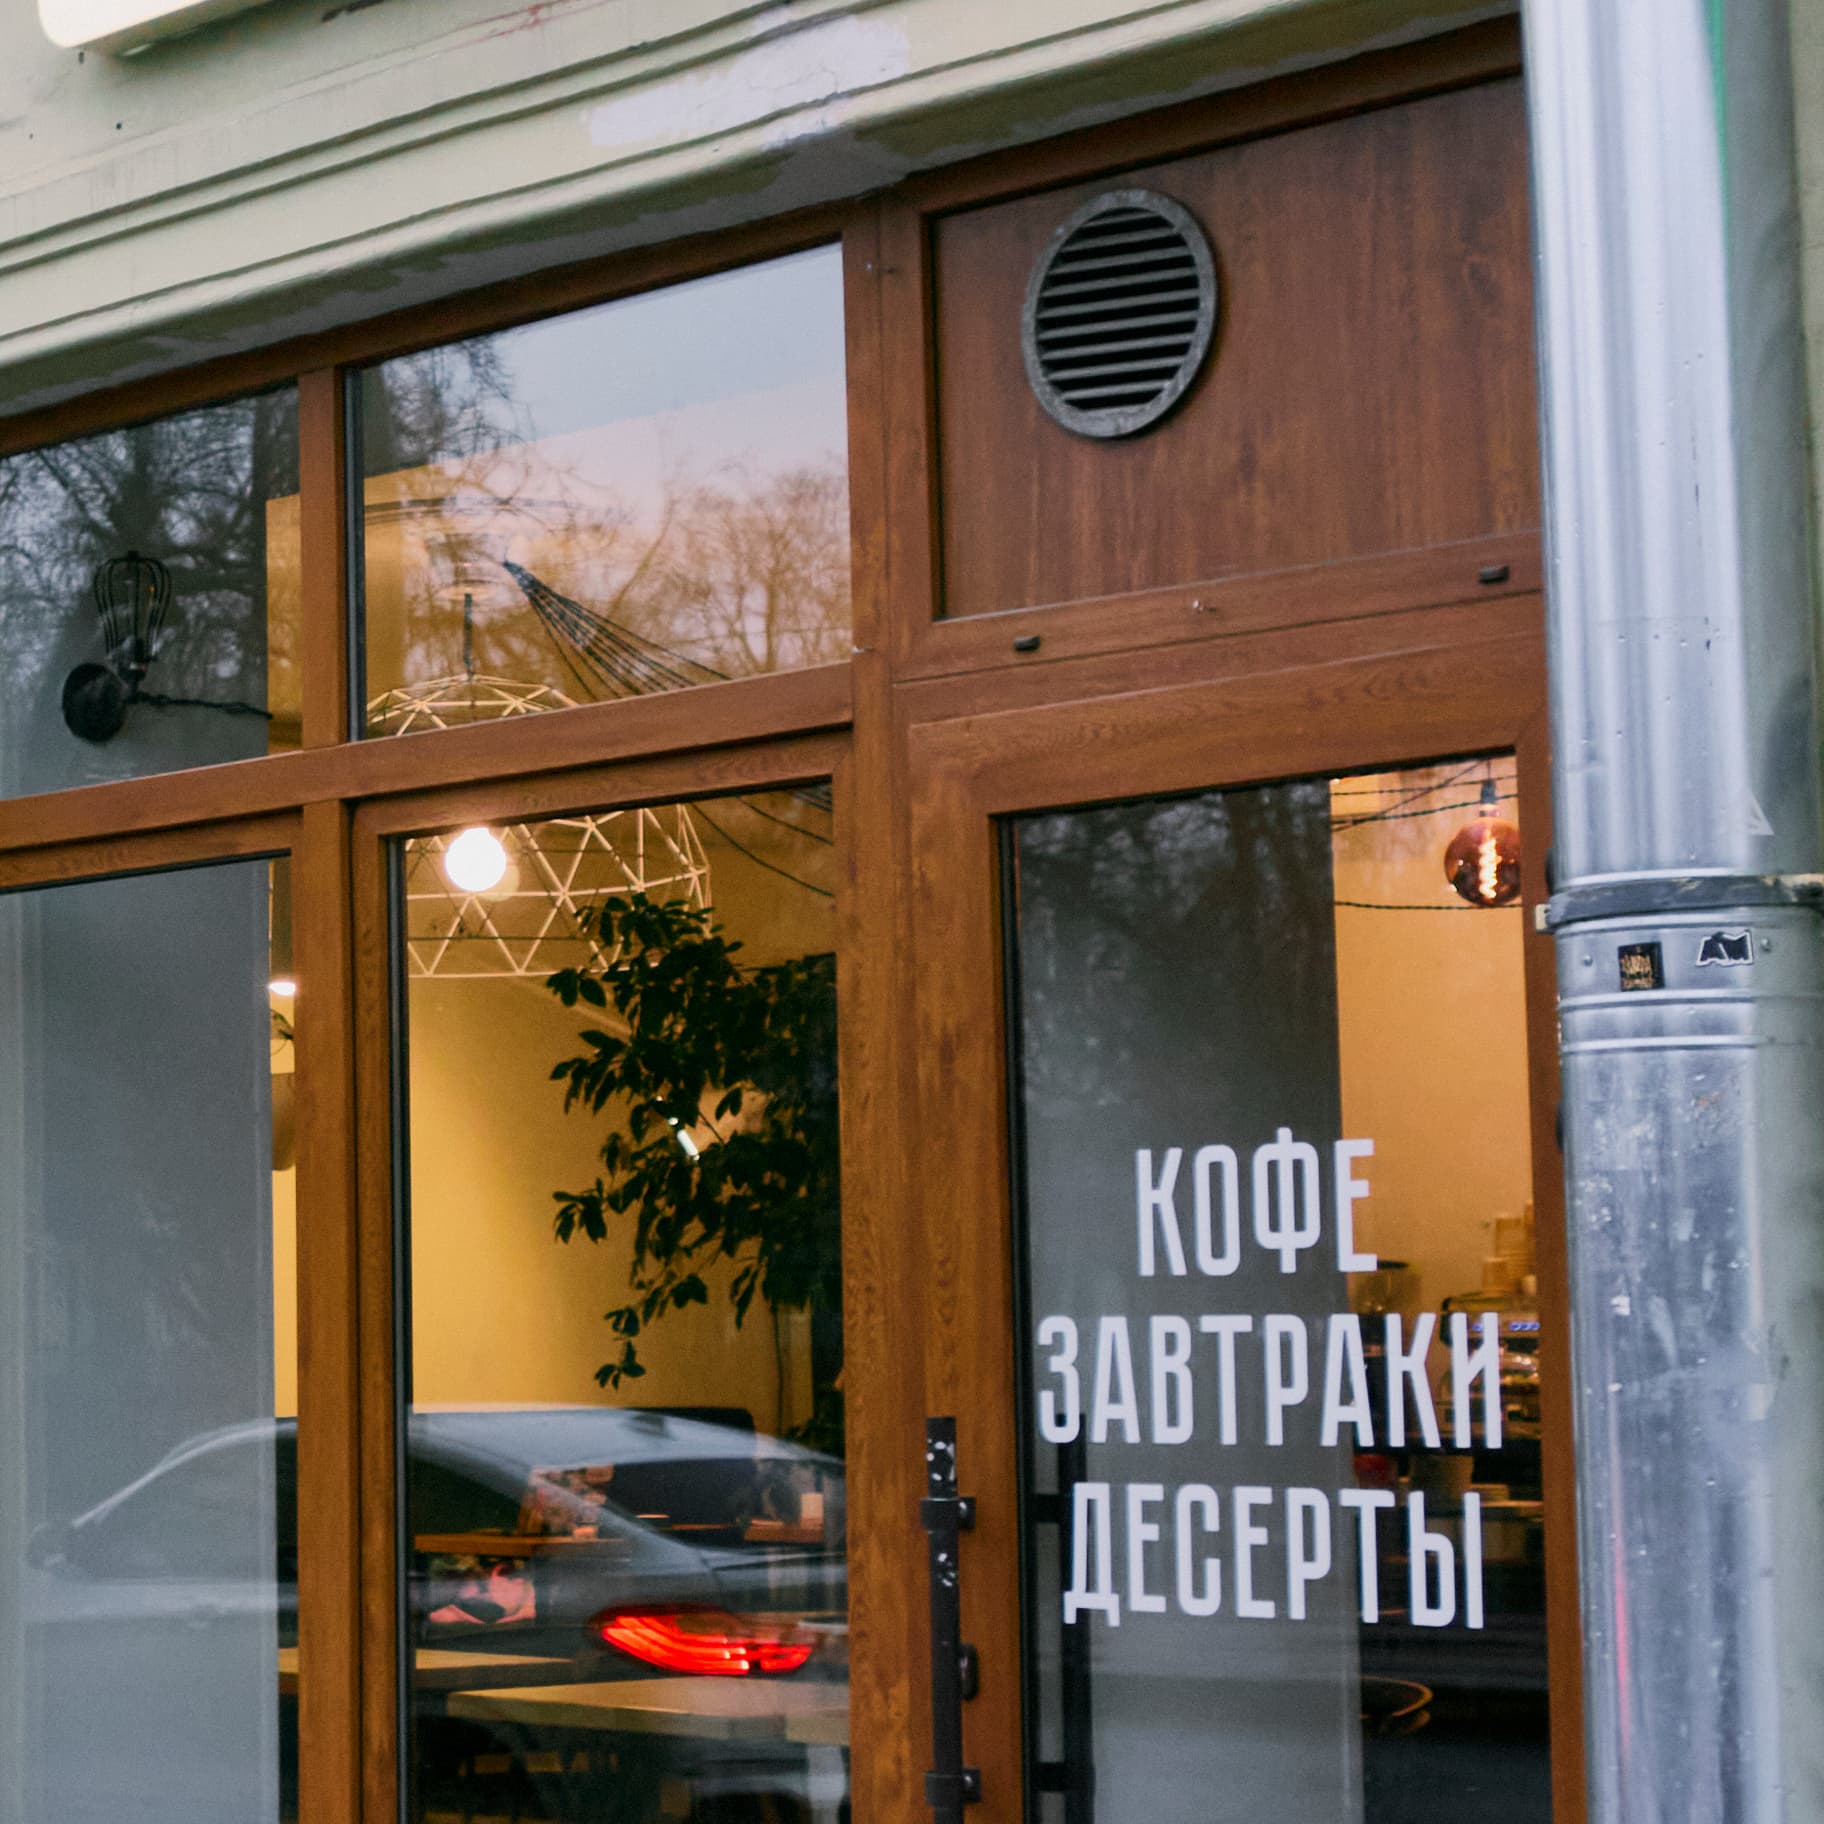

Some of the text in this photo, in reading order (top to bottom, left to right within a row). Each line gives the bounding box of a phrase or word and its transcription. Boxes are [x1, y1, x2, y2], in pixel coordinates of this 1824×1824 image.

[1134, 1126, 1378, 1277] КОФЕ
[1036, 1310, 1504, 1450] ЗАВТРАКИ
[1062, 1481, 1485, 1630] ДЕСЕРТЫ
